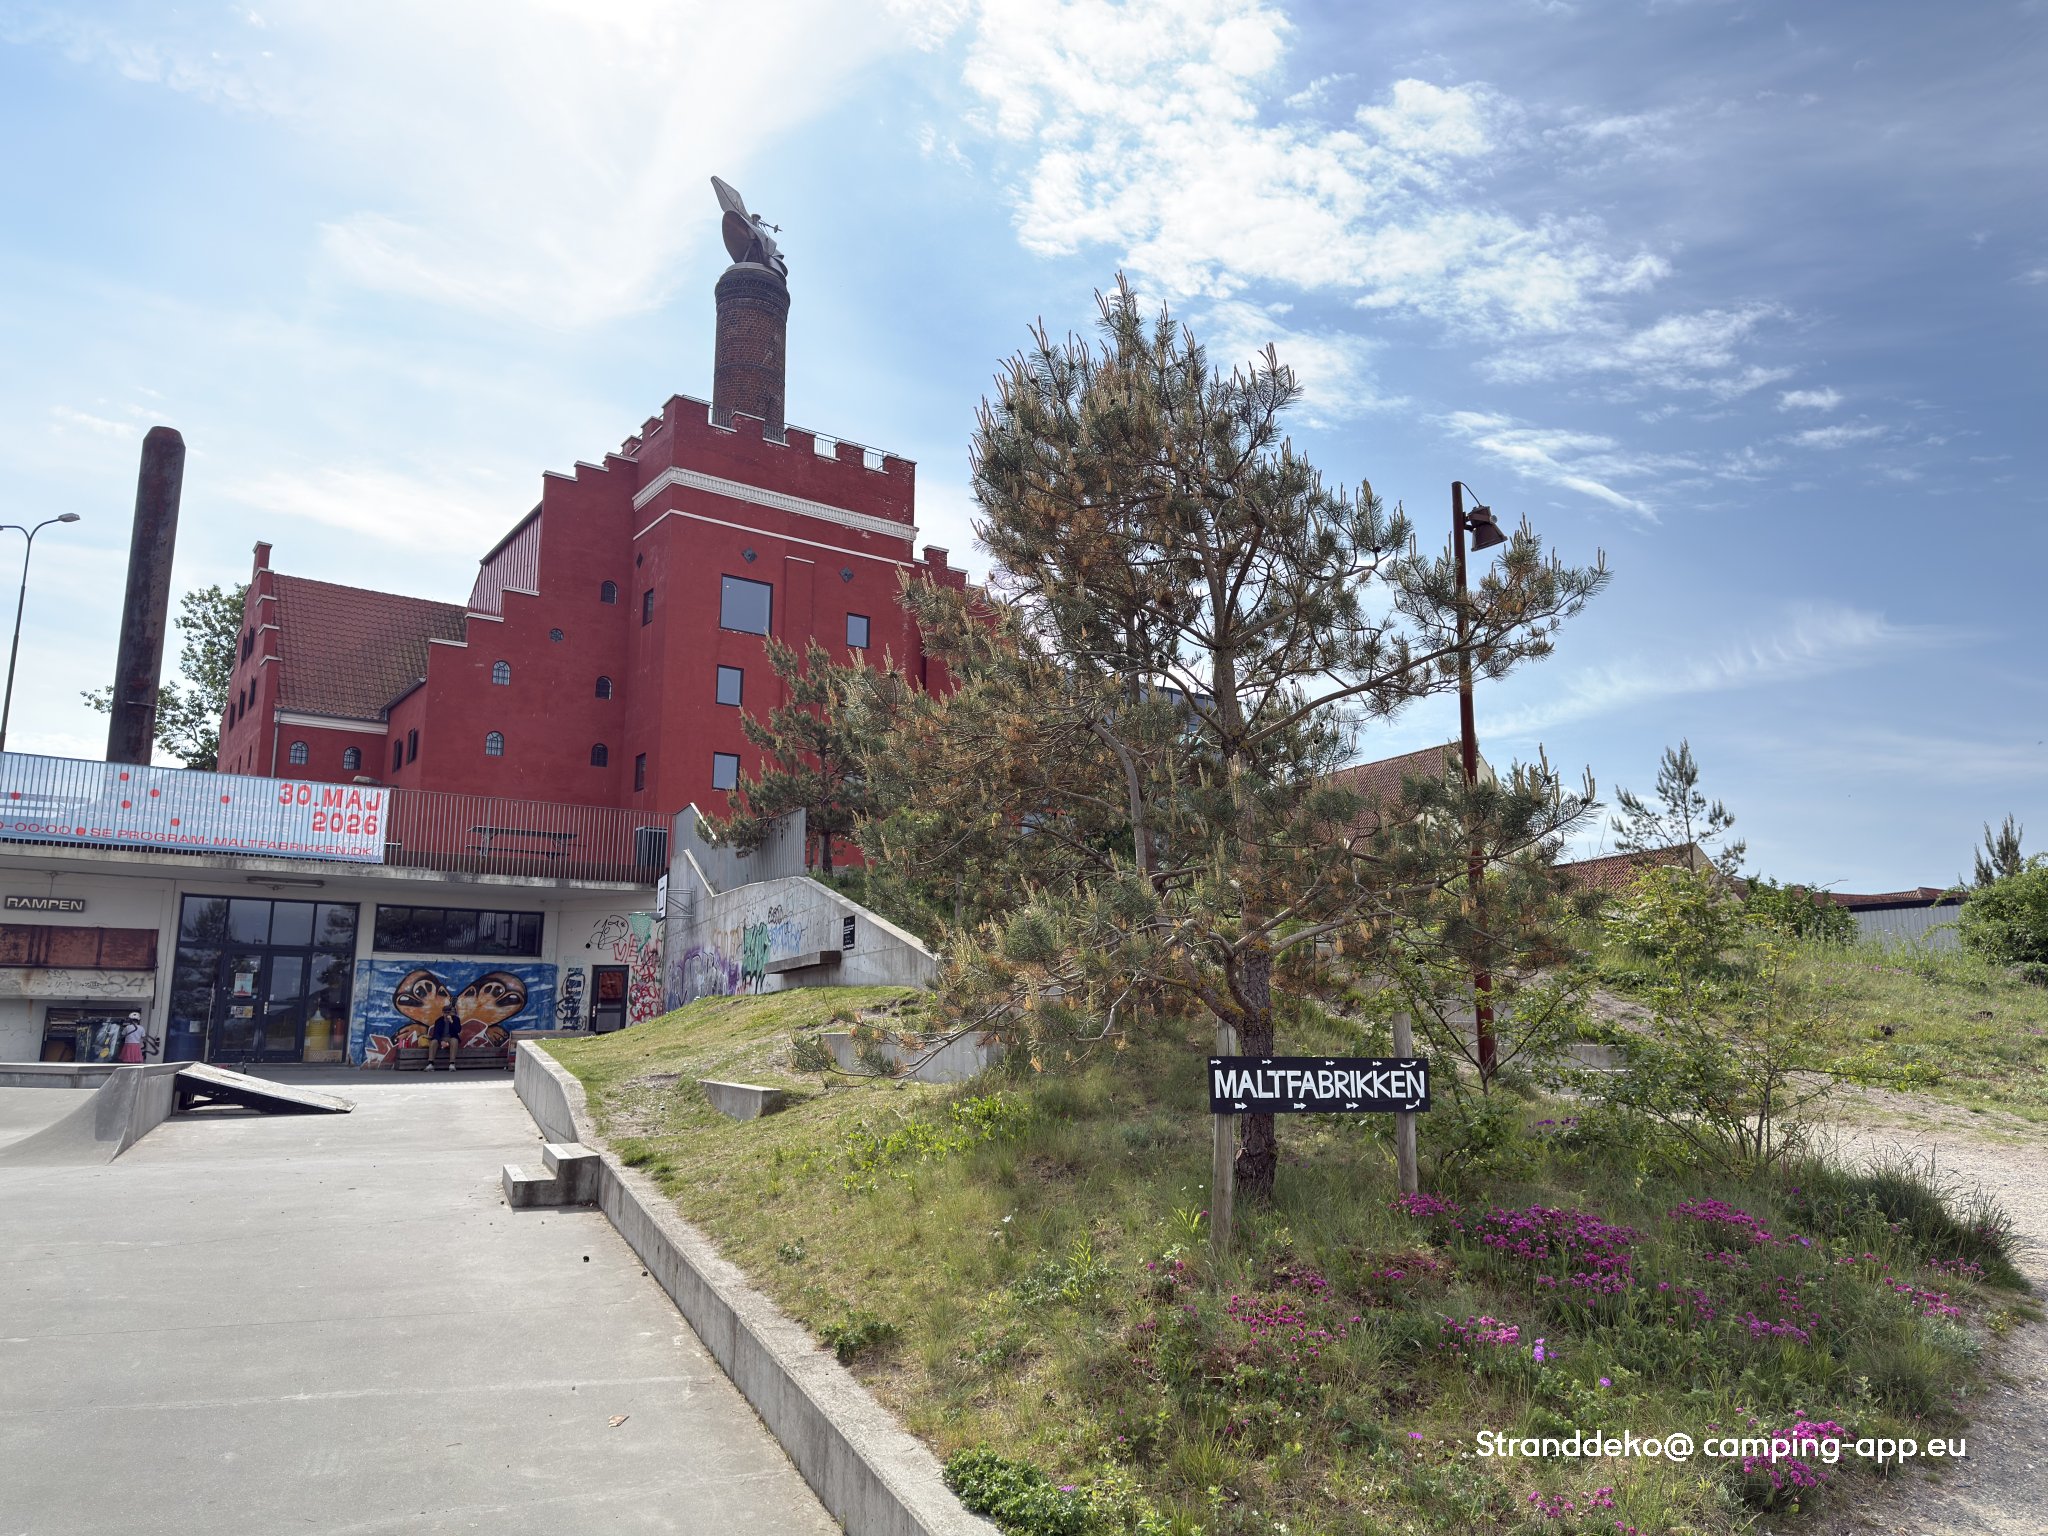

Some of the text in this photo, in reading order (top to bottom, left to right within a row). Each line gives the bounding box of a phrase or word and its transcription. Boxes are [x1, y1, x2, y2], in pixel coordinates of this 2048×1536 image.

[234, 795, 272, 808] MAD
[279, 783, 382, 811] 30.MAJ
[312, 810, 378, 836] 2026
[90, 827, 113, 839] SE
[117, 829, 209, 846] PROGRAM:
[213, 836, 373, 856] MALTFABRIKKEN.DK
[7, 897, 84, 911] RAMPEN
[1214, 1069, 1426, 1099] MALTFABRIKKEN
